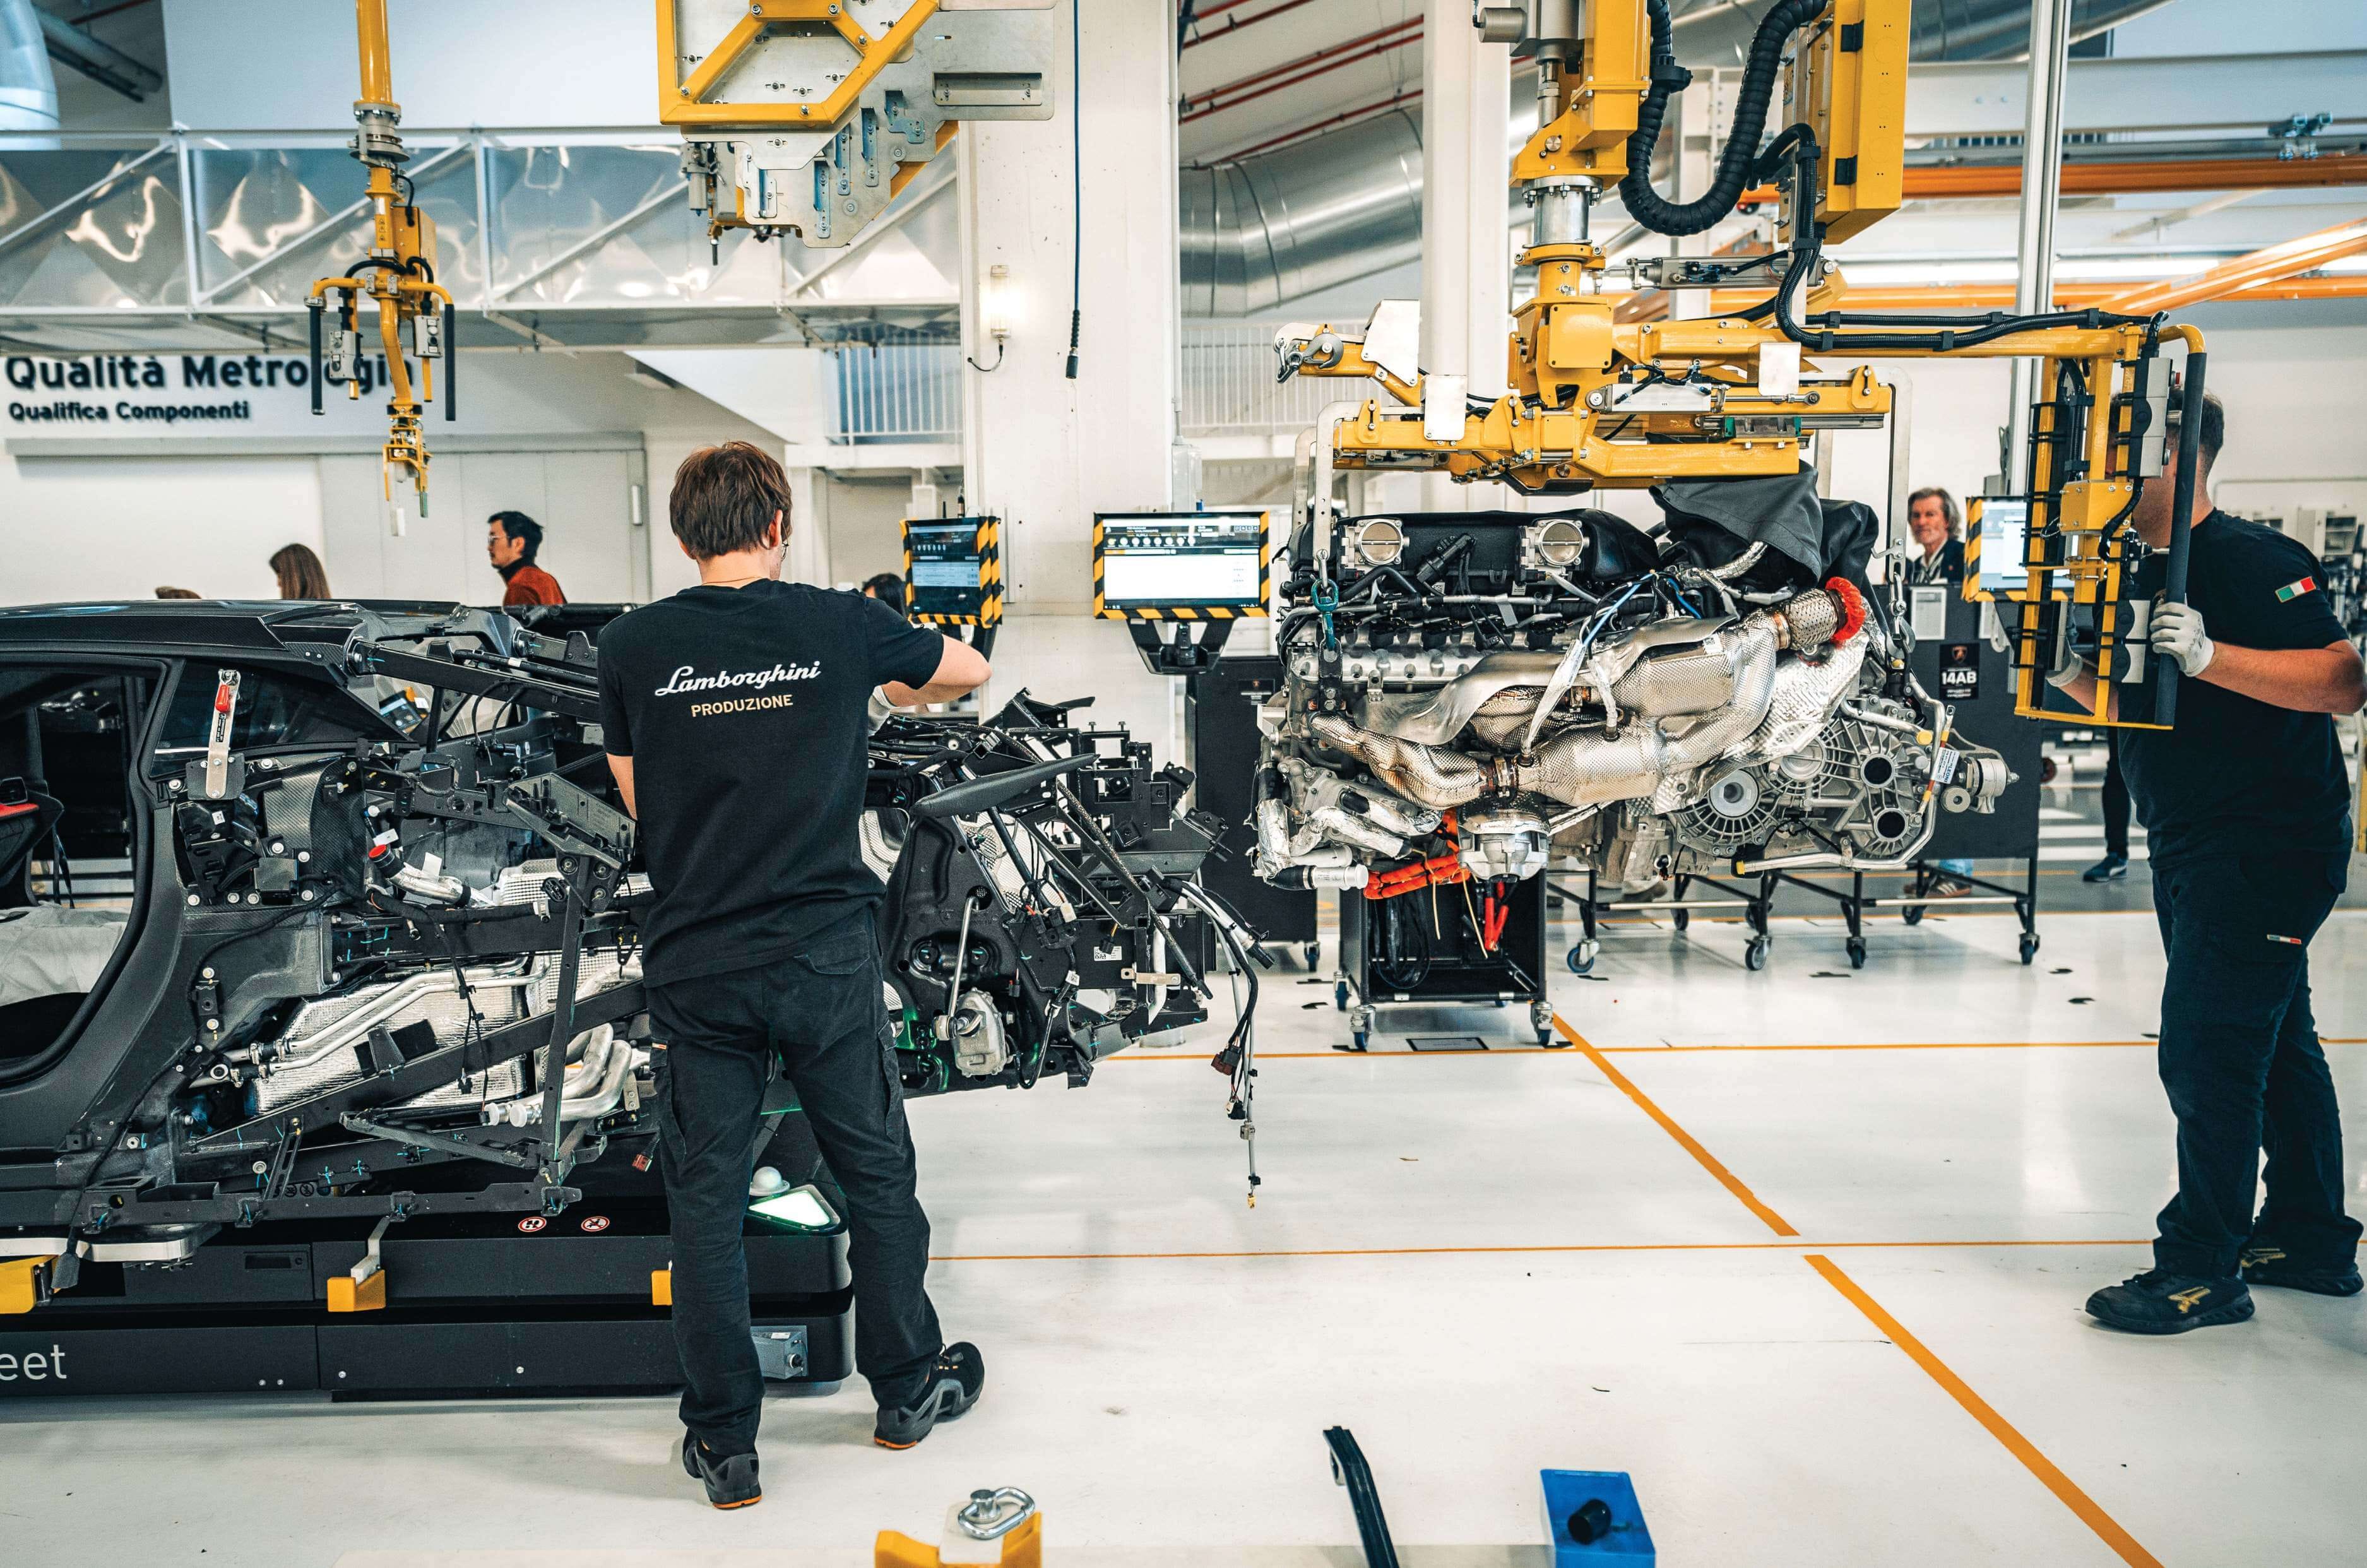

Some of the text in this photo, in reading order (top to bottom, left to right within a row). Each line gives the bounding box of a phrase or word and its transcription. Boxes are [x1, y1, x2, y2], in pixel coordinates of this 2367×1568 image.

[6, 355, 413, 395] Qualità Metrogi
[9, 401, 249, 424] Qualifica Componenti
[655, 660, 822, 696] Lamborghini
[1942, 671, 1977, 685] 14AB
[690, 694, 793, 718] PRODUZIONE
